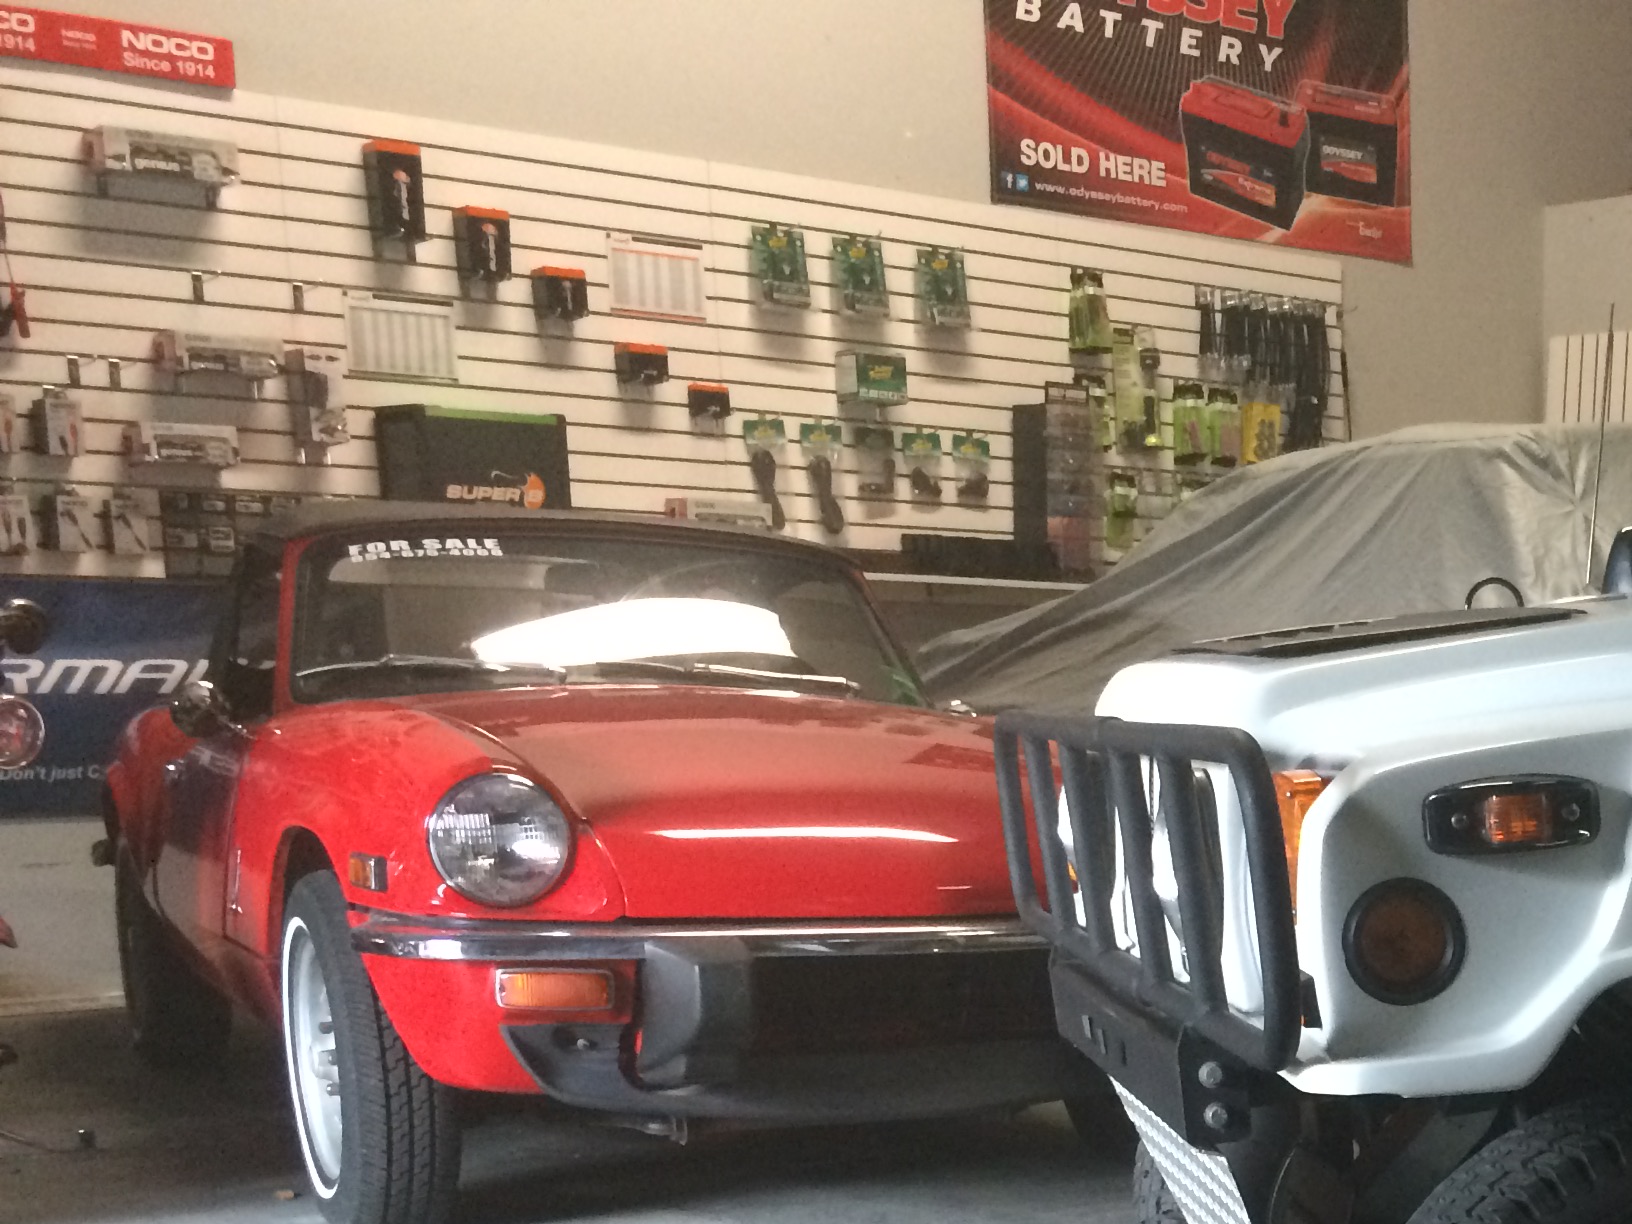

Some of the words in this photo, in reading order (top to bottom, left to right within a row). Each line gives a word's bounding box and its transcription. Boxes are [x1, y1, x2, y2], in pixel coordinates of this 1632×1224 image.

[120, 29, 215, 61] NOCO
[1015, 0, 1284, 73] BATTERY
[122, 50, 172, 73] Since
[176, 60, 216, 79] 1914
[1020, 137, 1091, 175] SOLD
[1098, 149, 1167, 188] HERE
[1034, 180, 1189, 213] www.odysseybattery.com
[446, 484, 521, 502] SUPER
[348, 540, 411, 557] FOR
[422, 538, 501, 550] SALE
[47, 764, 84, 783] just
